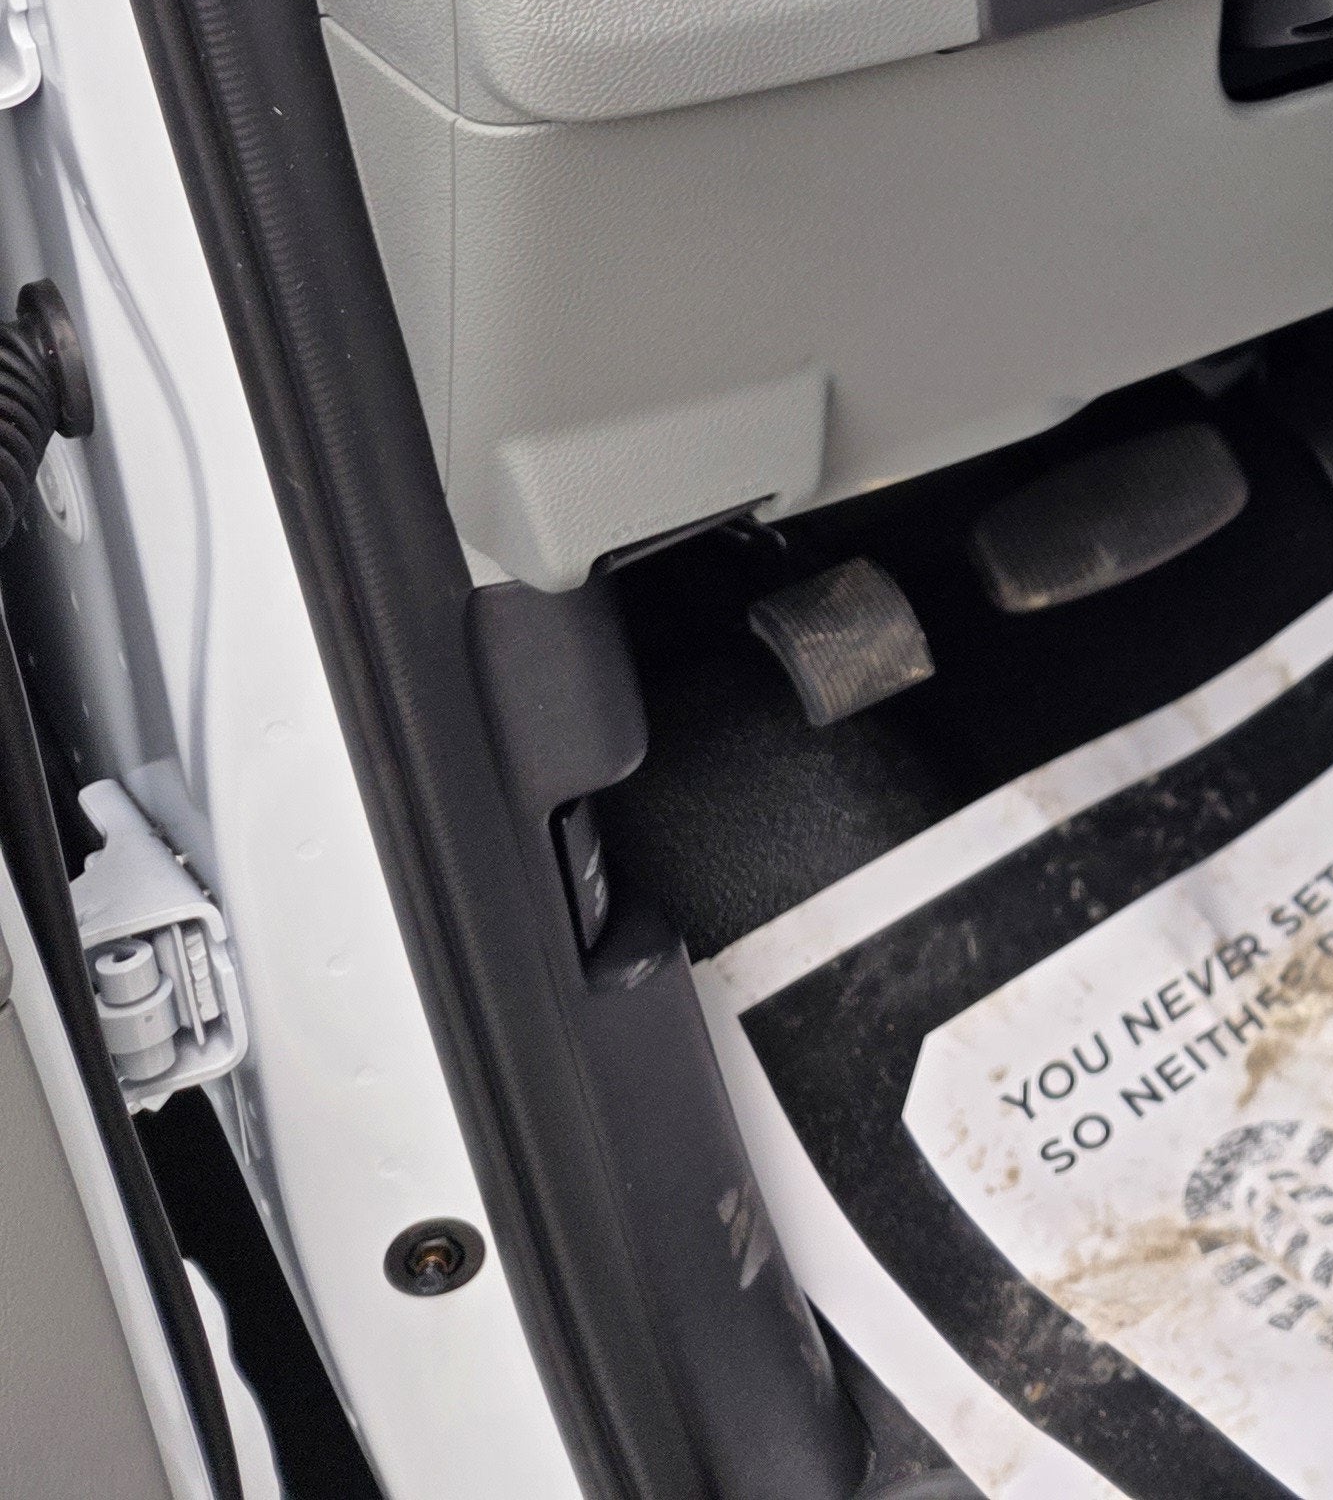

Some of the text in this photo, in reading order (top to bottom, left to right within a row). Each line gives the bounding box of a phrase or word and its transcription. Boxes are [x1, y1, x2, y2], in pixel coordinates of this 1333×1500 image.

[1000, 1032, 1112, 1120] YOU
[1121, 933, 1268, 1045] NEVER
[1040, 1113, 1112, 1174] SO
